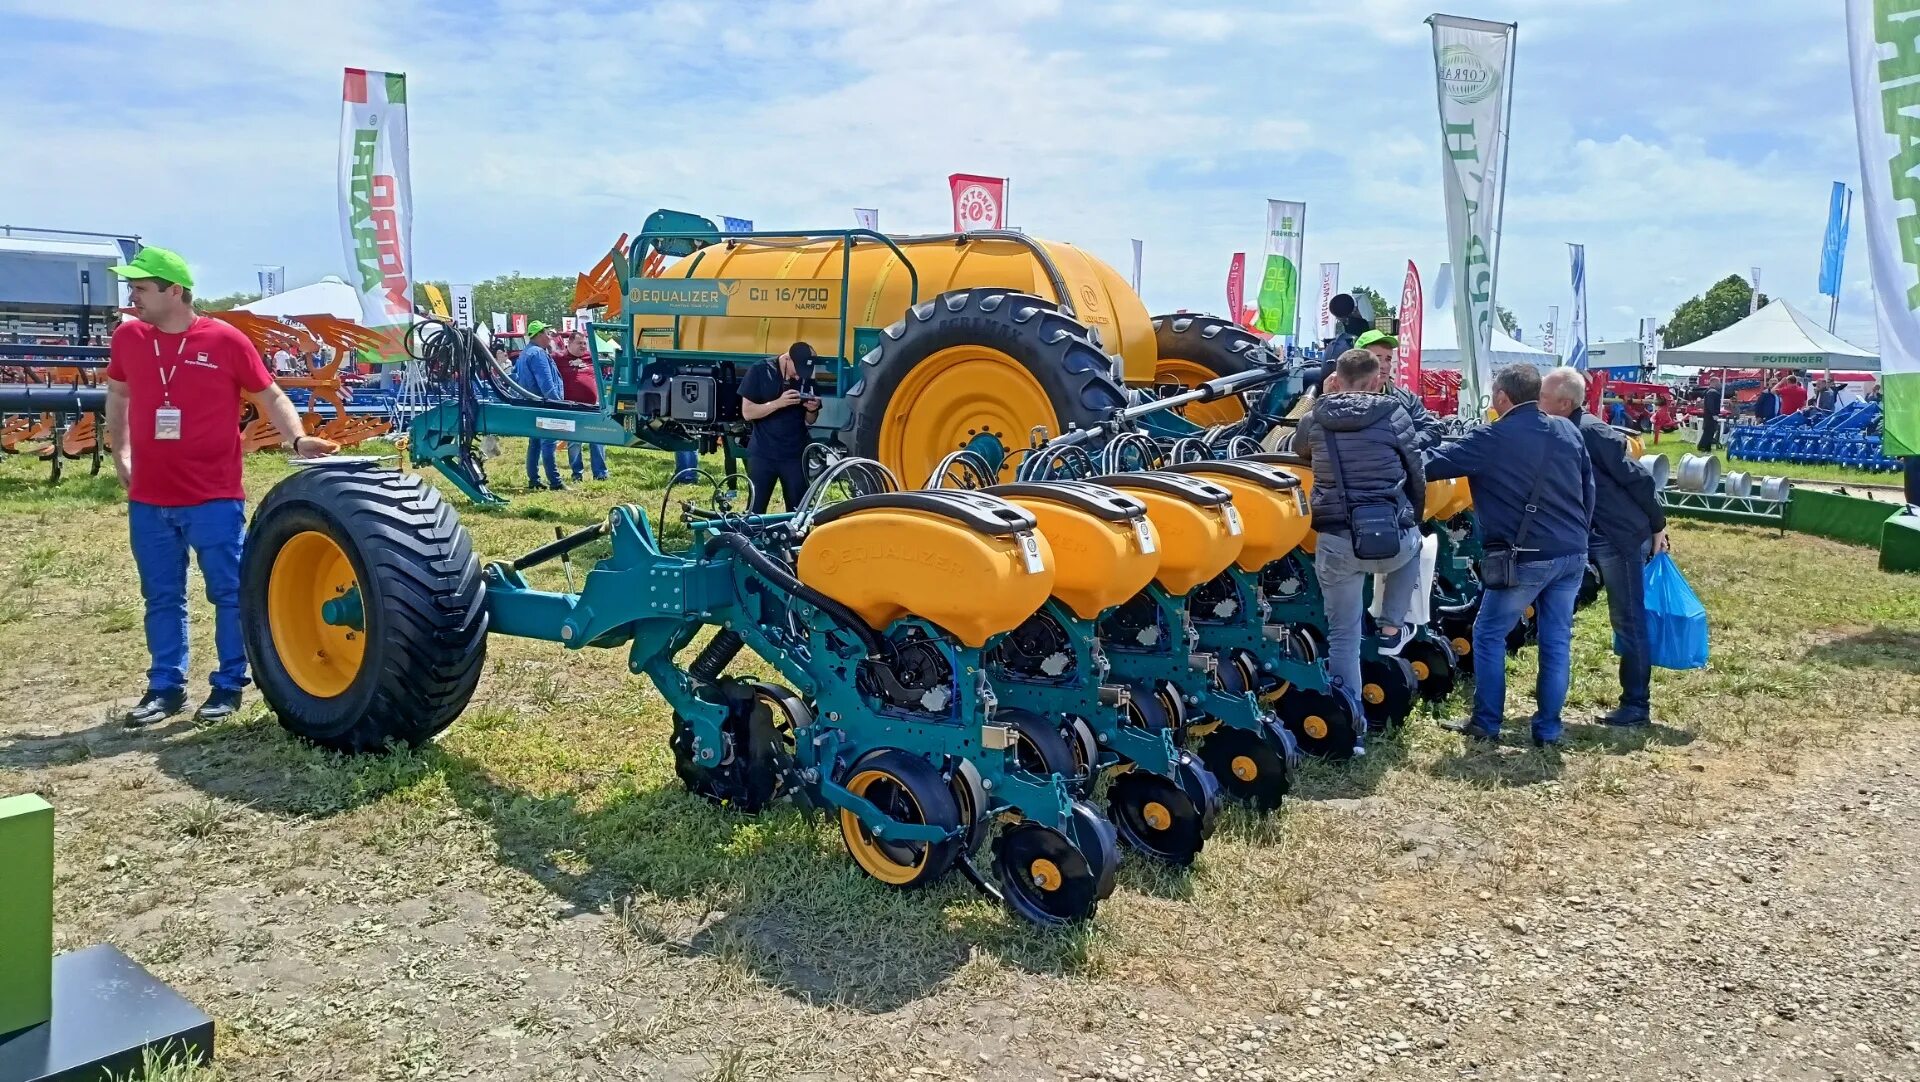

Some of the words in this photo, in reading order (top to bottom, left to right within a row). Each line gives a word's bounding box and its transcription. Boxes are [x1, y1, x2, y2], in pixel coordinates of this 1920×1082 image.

[643, 290, 719, 303] EQUALIZER
[775, 287, 829, 302] 16/700
[1400, 332, 1410, 390] STYER
[840, 543, 965, 577] EQUALIZER
